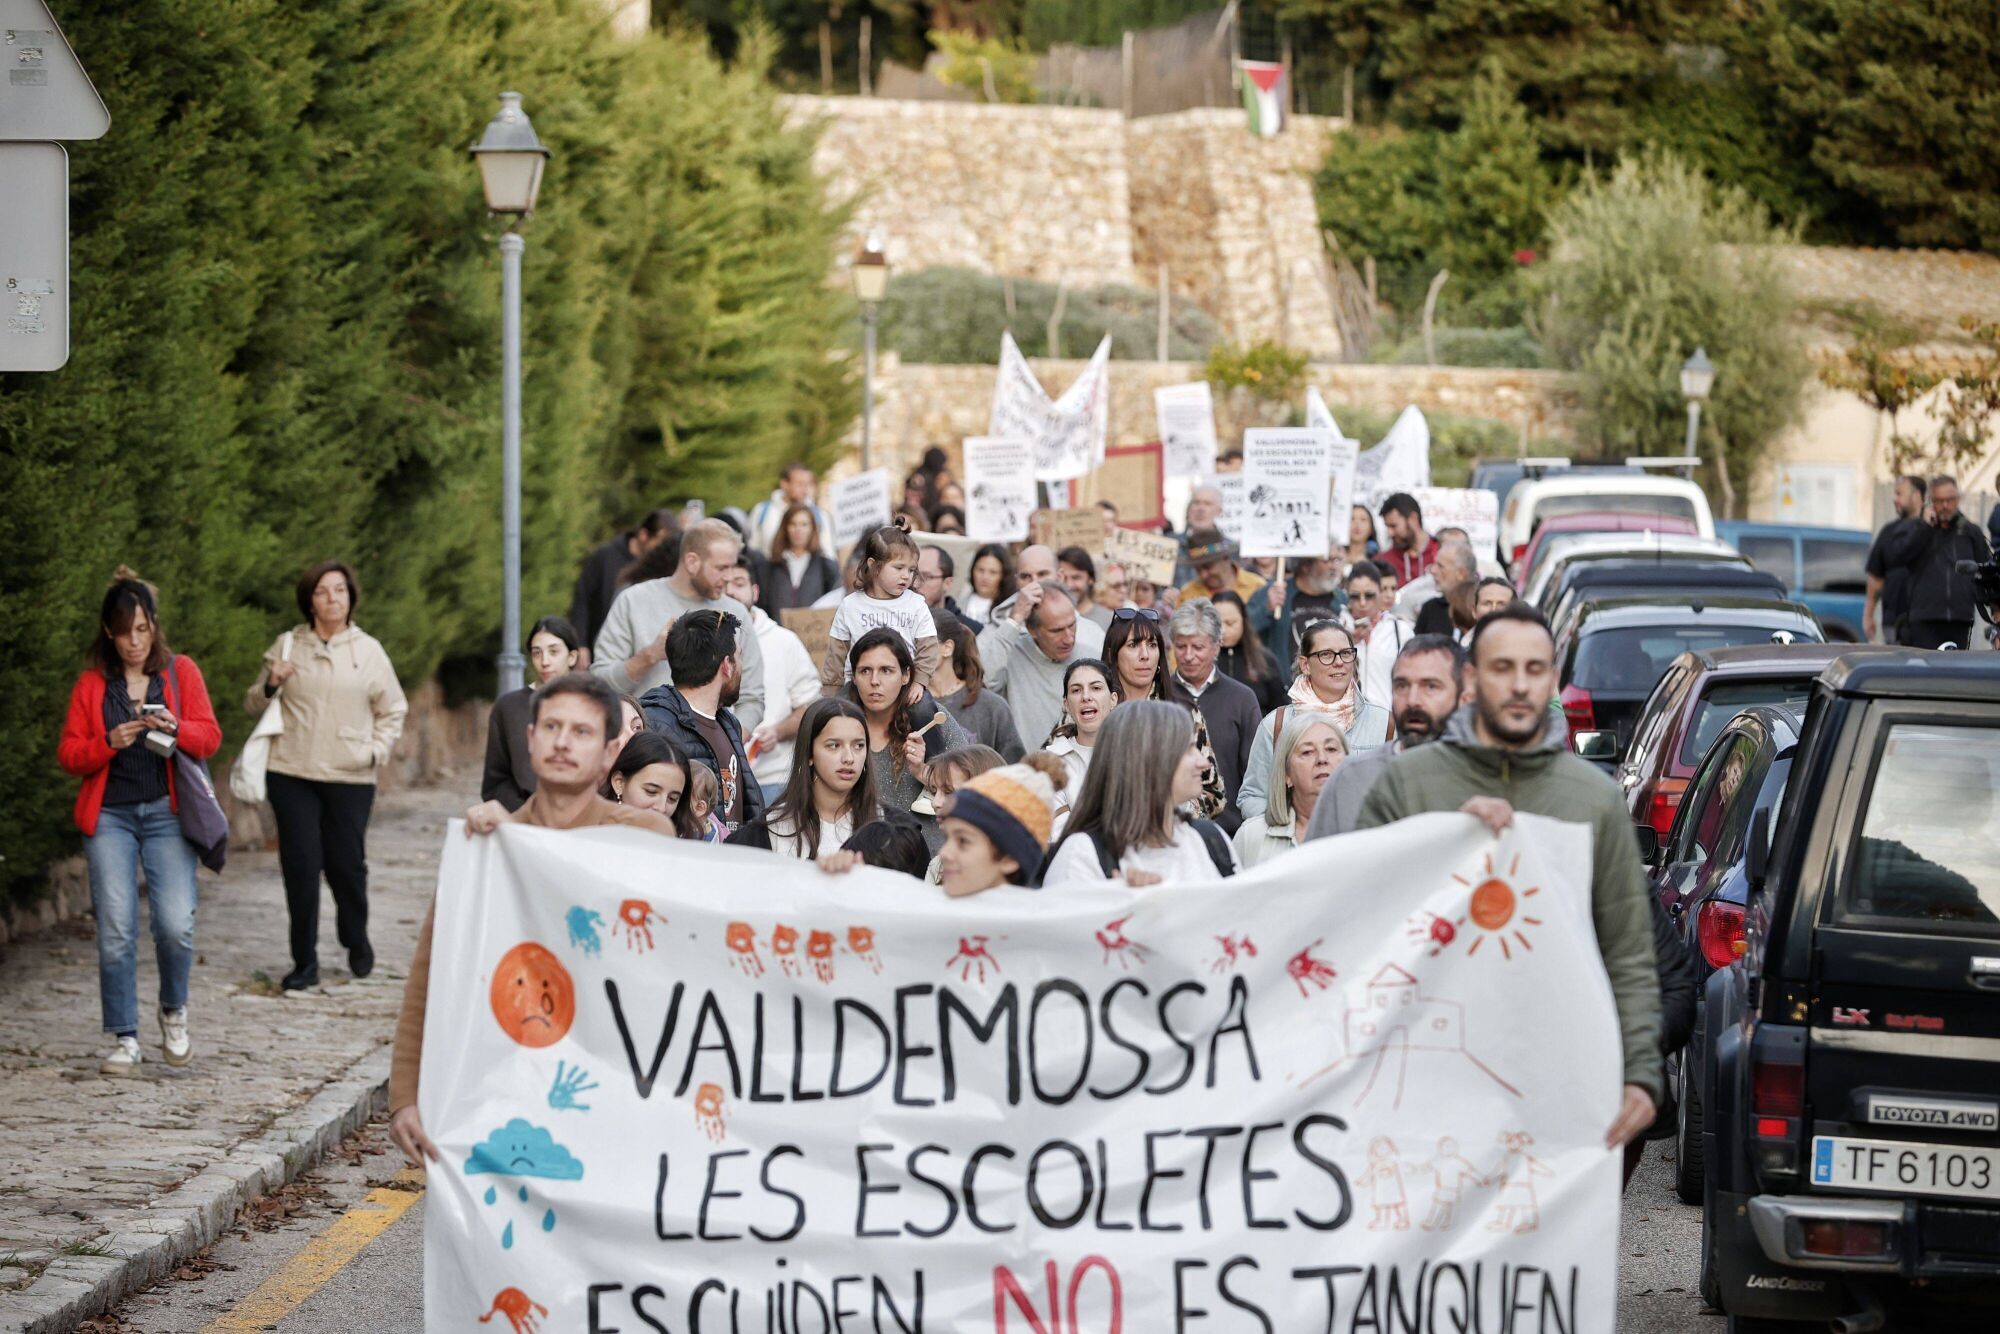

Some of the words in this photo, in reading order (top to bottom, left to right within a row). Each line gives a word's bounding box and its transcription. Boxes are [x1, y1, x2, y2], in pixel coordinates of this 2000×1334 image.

[604, 974, 1262, 1107] VALLDEMOSSA
[1832, 1006, 1871, 1026] LX
[1876, 1105, 1946, 1124] TOYOTA
[1951, 1111, 1996, 1128] 4WD
[654, 1143, 806, 1243] LES
[855, 1112, 1353, 1239] ESCOLETES
[992, 1254, 1123, 1334] NO
[1173, 1255, 1274, 1334] ES
[1292, 1258, 1579, 1334] TANQUEN
